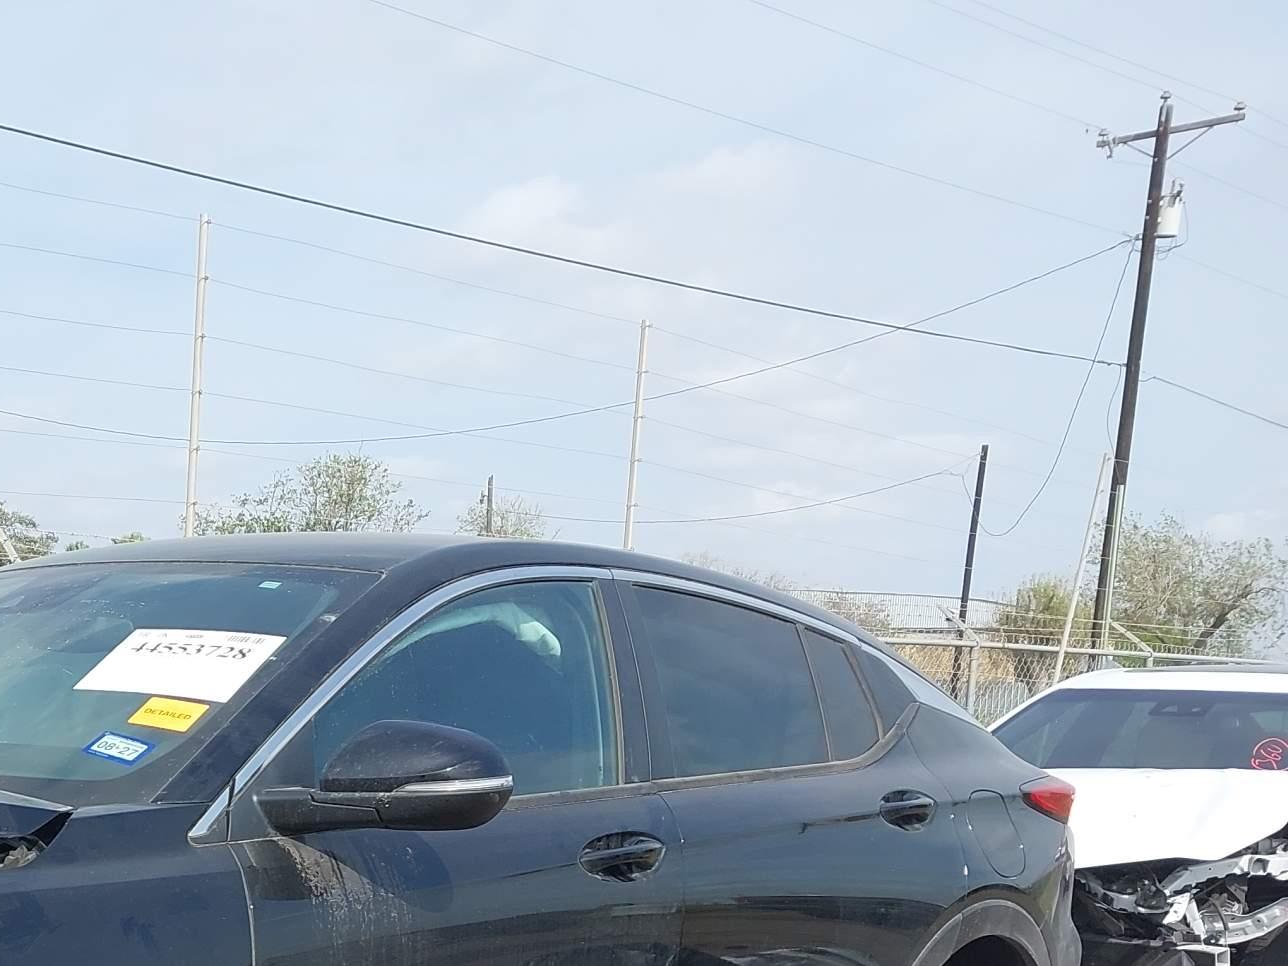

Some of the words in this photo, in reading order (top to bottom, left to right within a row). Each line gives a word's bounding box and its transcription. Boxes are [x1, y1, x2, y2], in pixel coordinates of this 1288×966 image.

[131, 642, 252, 660] 44553728
[143, 707, 192, 720] DETAILED
[97, 741, 117, 751] 08
[118, 746, 139, 757] 27
